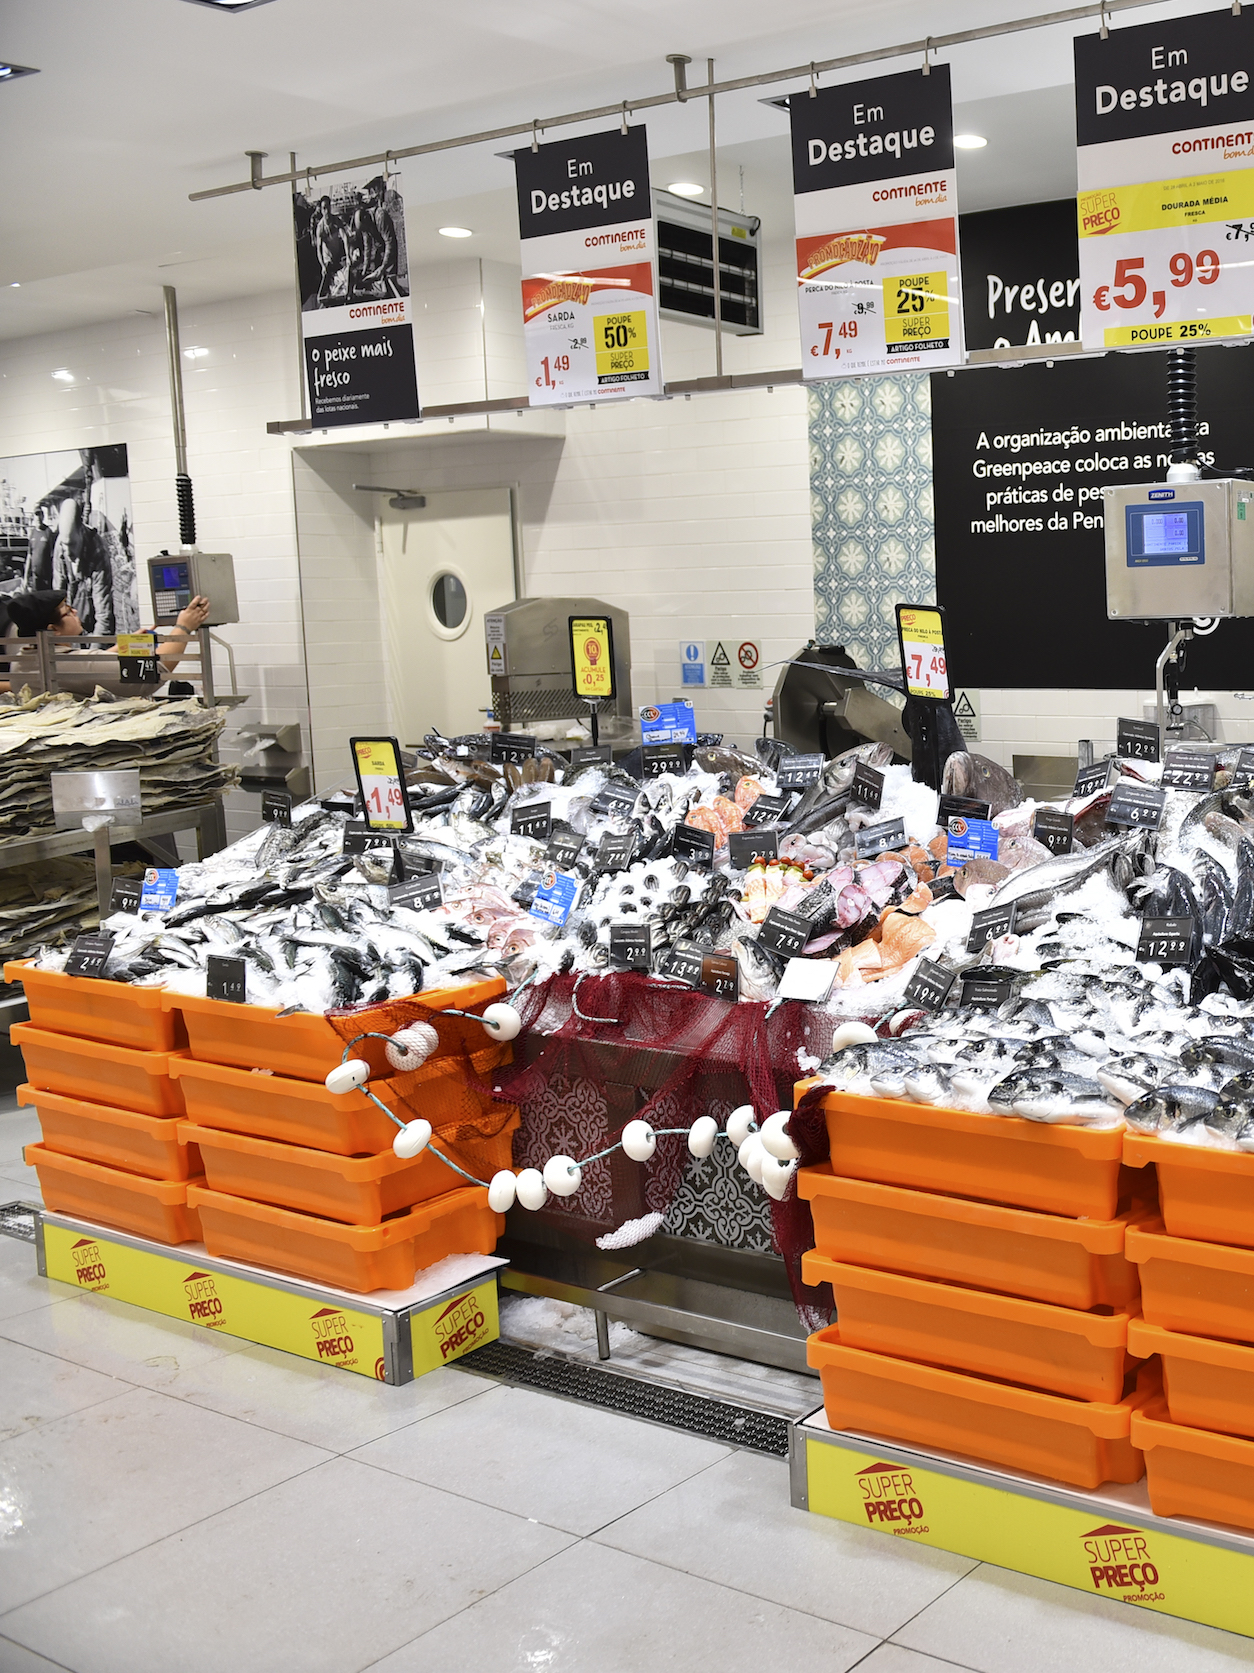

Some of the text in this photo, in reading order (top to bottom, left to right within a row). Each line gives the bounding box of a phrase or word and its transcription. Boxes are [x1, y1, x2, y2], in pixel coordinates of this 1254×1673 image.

[1151, 46, 1188, 70] Em
[1096, 70, 1249, 115] Destaque
[853, 103, 884, 125] Em
[808, 125, 935, 166] Destaque
[568, 159, 593, 178] Em
[531, 180, 635, 214] Destaque
[873, 180, 946, 202] CONTINENTE
[1080, 192, 1117, 216] SUPER
[1162, 196, 1228, 210] DOURADA MÉDIA
[1083, 207, 1120, 230] PREÇO
[585, 229, 646, 247] CONTINENTE
[900, 276, 929, 287] POUPE
[349, 302, 404, 318] CONTINENTE
[548, 311, 575, 322] SARDA
[607, 315, 631, 325] POUPE
[903, 317, 930, 327] SUPER
[903, 326, 931, 338] PREÇO
[1131, 323, 1211, 341] POUPE 25%
[604, 325, 636, 348] 50%
[325, 342, 356, 371] peixe
[361, 336, 393, 357] mais
[611, 360, 634, 371] PREÇO
[314, 367, 350, 396] fresco
[342, 394, 369, 402] diariamente
[976, 426, 1091, 453] A organização
[972, 452, 1152, 481] Greenpeace coloca as
[986, 486, 1048, 511] práticas
[1052, 482, 1074, 501] de
[971, 514, 1043, 533] melhores
[1048, 511, 1068, 530] da
[71, 1245, 101, 1268] SUPER
[76, 1263, 106, 1286] PREÇO
[184, 1279, 217, 1302] SUPER
[189, 1298, 222, 1321] PREÇO
[433, 1295, 480, 1345] SUPER
[311, 1315, 348, 1340] SUPER
[439, 1312, 485, 1360] PREÇO
[316, 1333, 354, 1360] PREÇO
[334, 1357, 358, 1368] PROMOÇÃO
[858, 1473, 917, 1500] SUPER
[864, 1497, 923, 1526] PREÇO
[893, 1525, 929, 1536] PROMOÇÃO
[1084, 1536, 1151, 1563] SUPER
[1089, 1562, 1159, 1593] PREÇO
[1123, 1592, 1166, 1603] PROMOÇÃO
